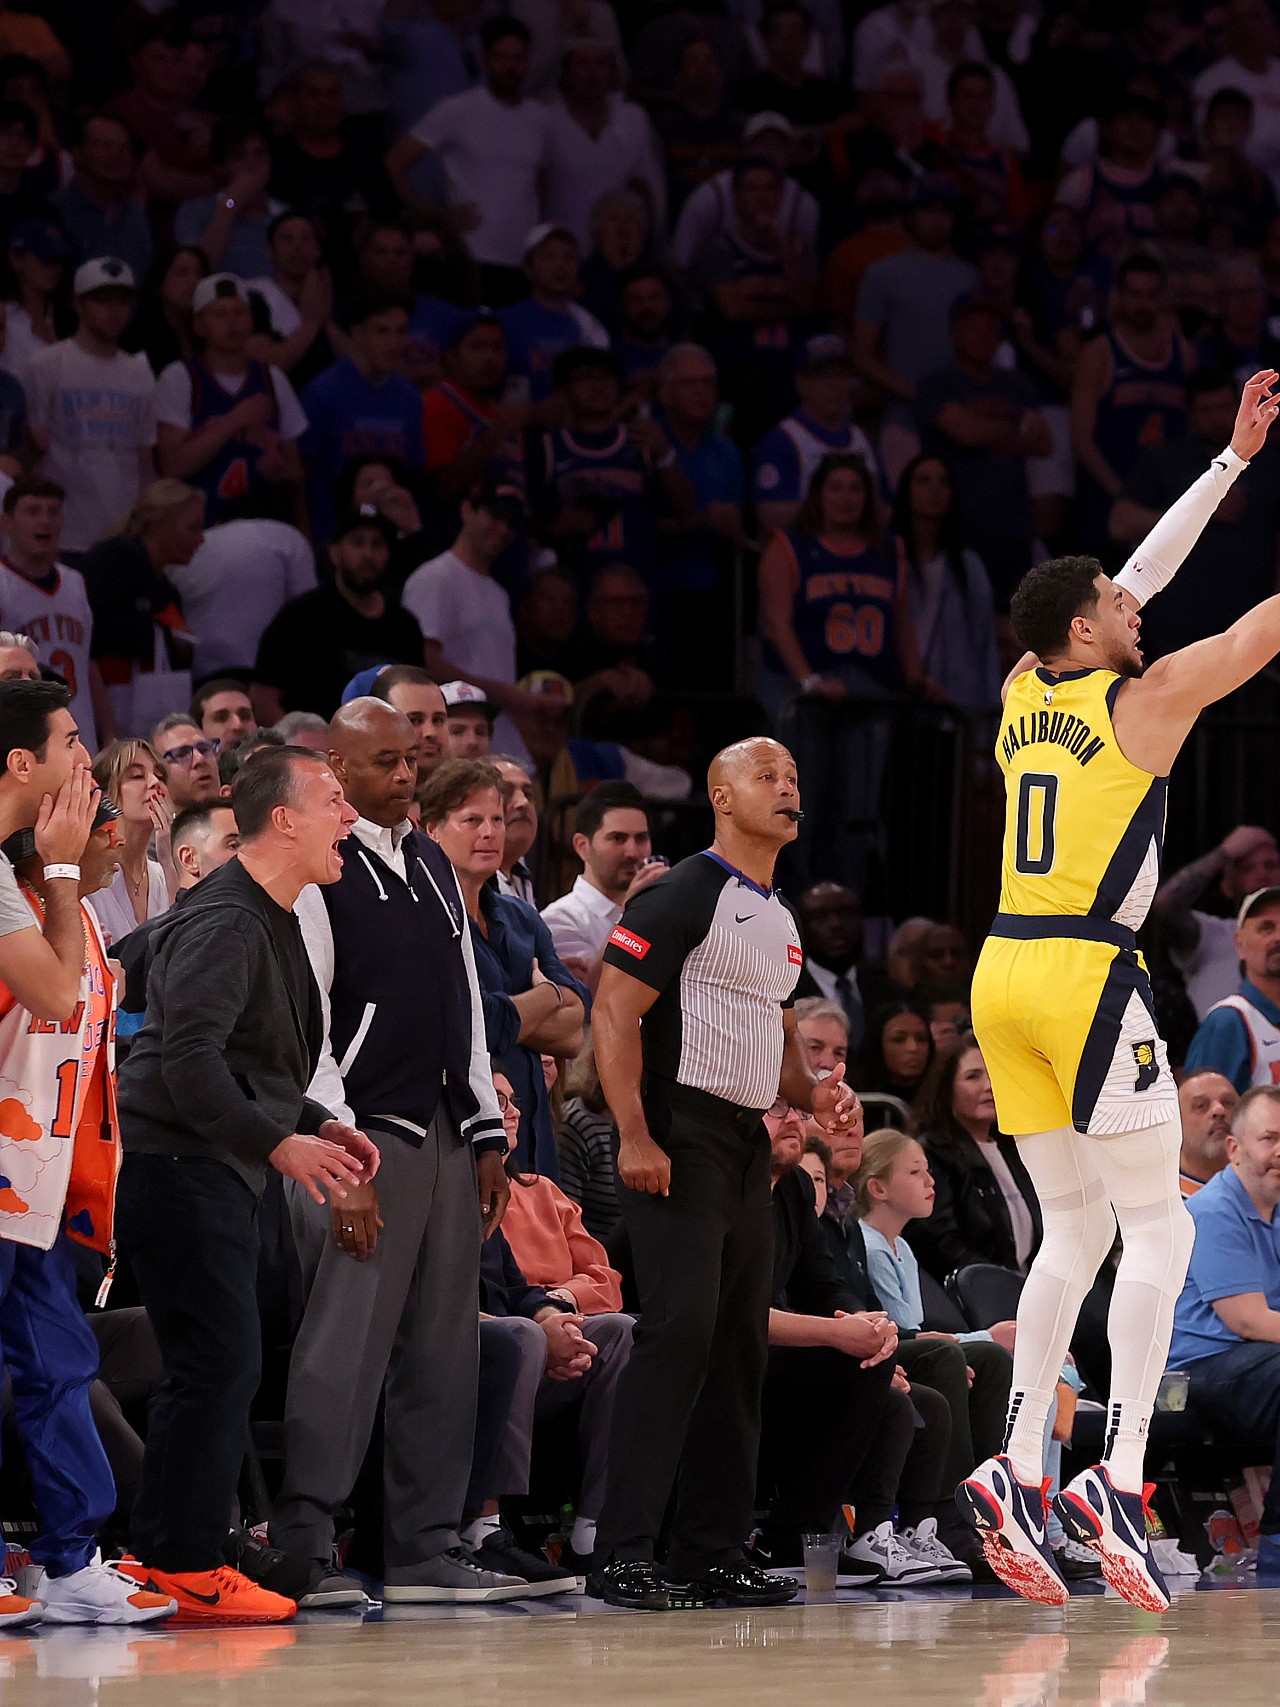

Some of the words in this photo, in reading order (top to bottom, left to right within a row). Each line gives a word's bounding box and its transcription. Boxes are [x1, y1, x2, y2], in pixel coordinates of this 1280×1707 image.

[824, 602, 885, 657] 60
[1002, 711, 1105, 767] HALIBURTON
[1015, 770, 1061, 876] 0
[611, 929, 642, 953] Emirates
[50, 1059, 80, 1138] 1
